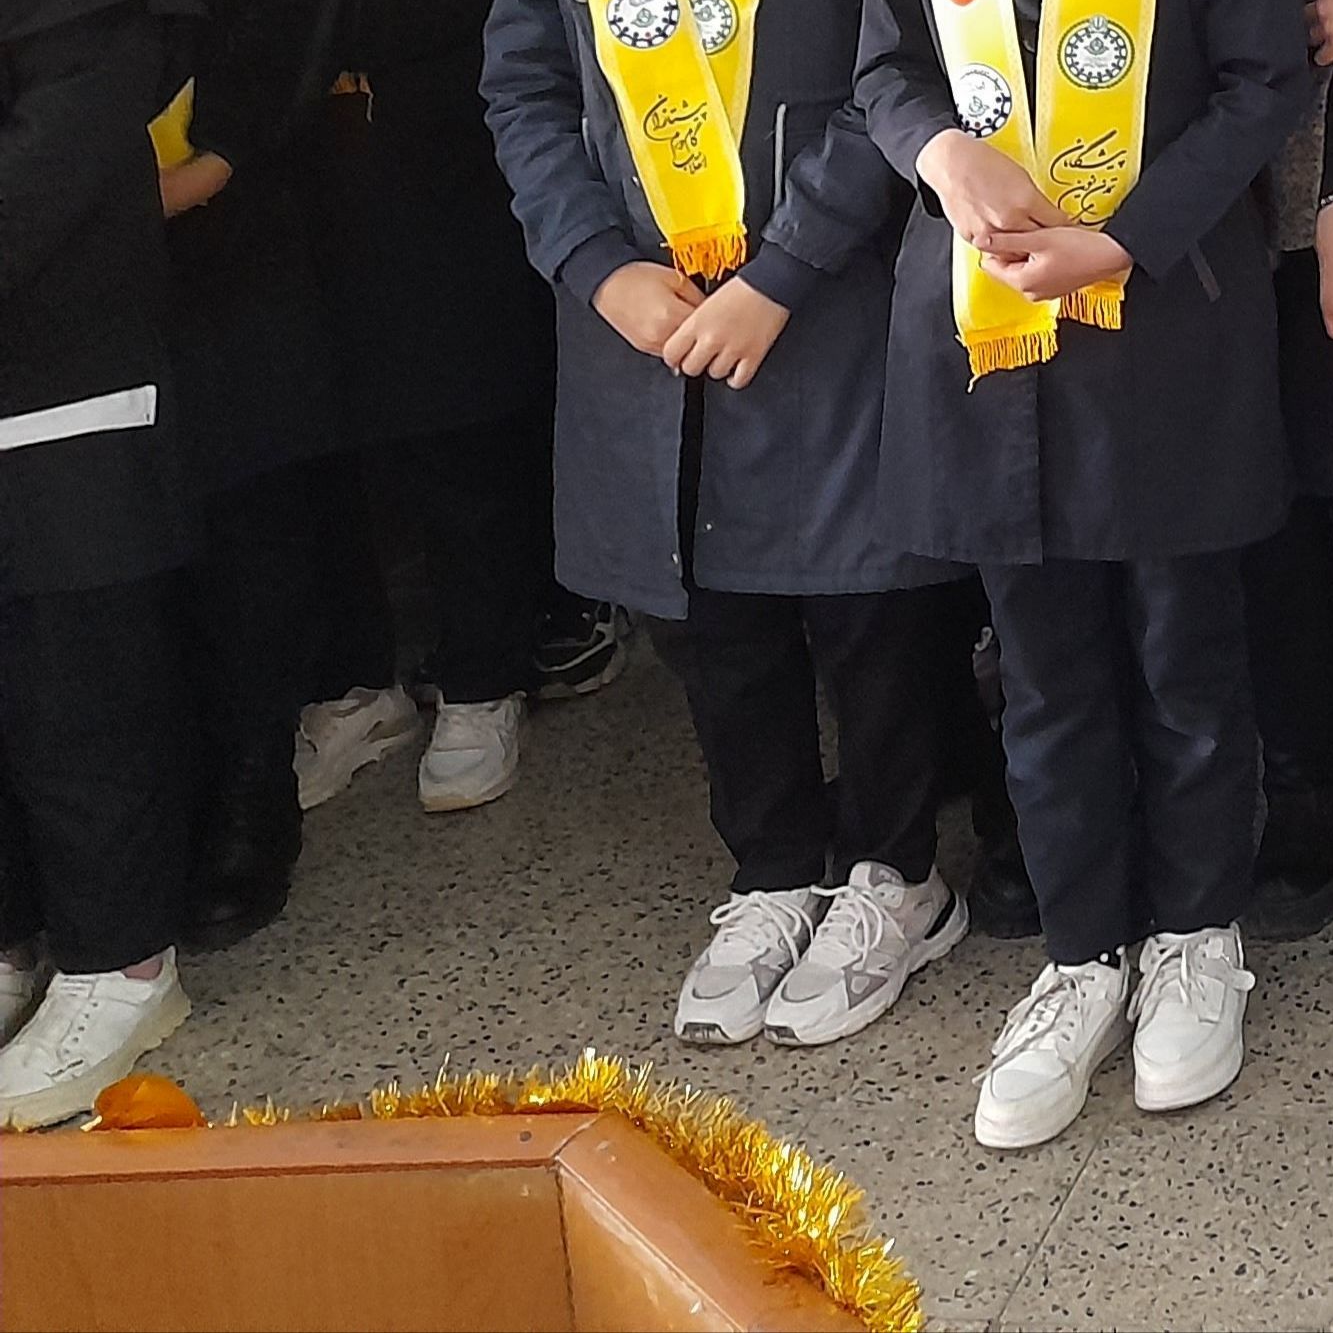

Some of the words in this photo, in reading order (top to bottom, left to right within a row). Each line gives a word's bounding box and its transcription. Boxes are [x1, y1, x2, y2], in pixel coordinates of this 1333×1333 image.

[643, 94, 708, 141] پیشتازان
[672, 151, 707, 175] انقلاب
[1049, 129, 1127, 186] پیشگامان
